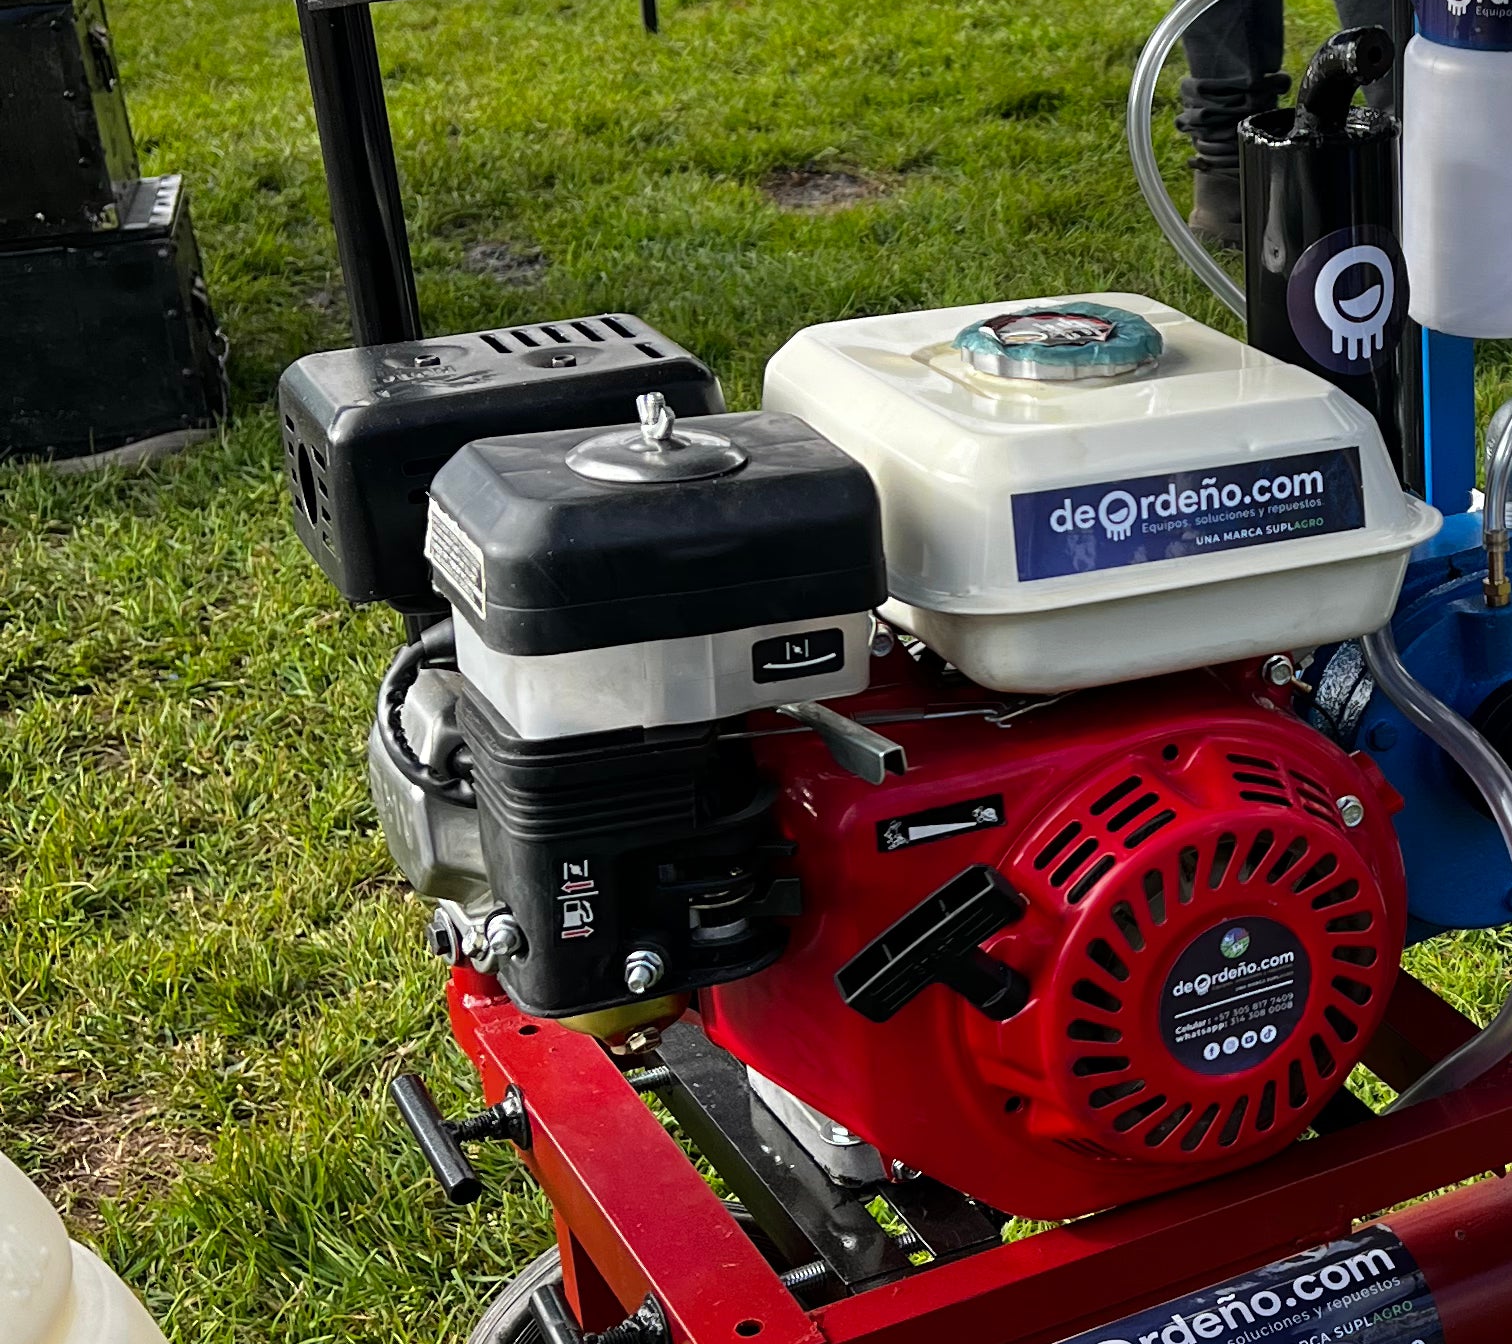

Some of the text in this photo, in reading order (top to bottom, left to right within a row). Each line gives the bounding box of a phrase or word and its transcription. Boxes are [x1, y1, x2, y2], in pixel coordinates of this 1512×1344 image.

[1049, 469, 1324, 542] deOrdeño.com
[1195, 508, 1256, 526] soluciones
[1258, 508, 1265, 519] y
[1267, 499, 1322, 514] repuestos
[1196, 517, 1325, 546] UNA MARCA SUPLAGRO
[1172, 950, 1295, 996] deOrdeño.com
[1313, 1305, 1323, 1320] y
[1326, 1276, 1401, 1312] repuestos
[1333, 1300, 1413, 1339] SUPLAGRO
